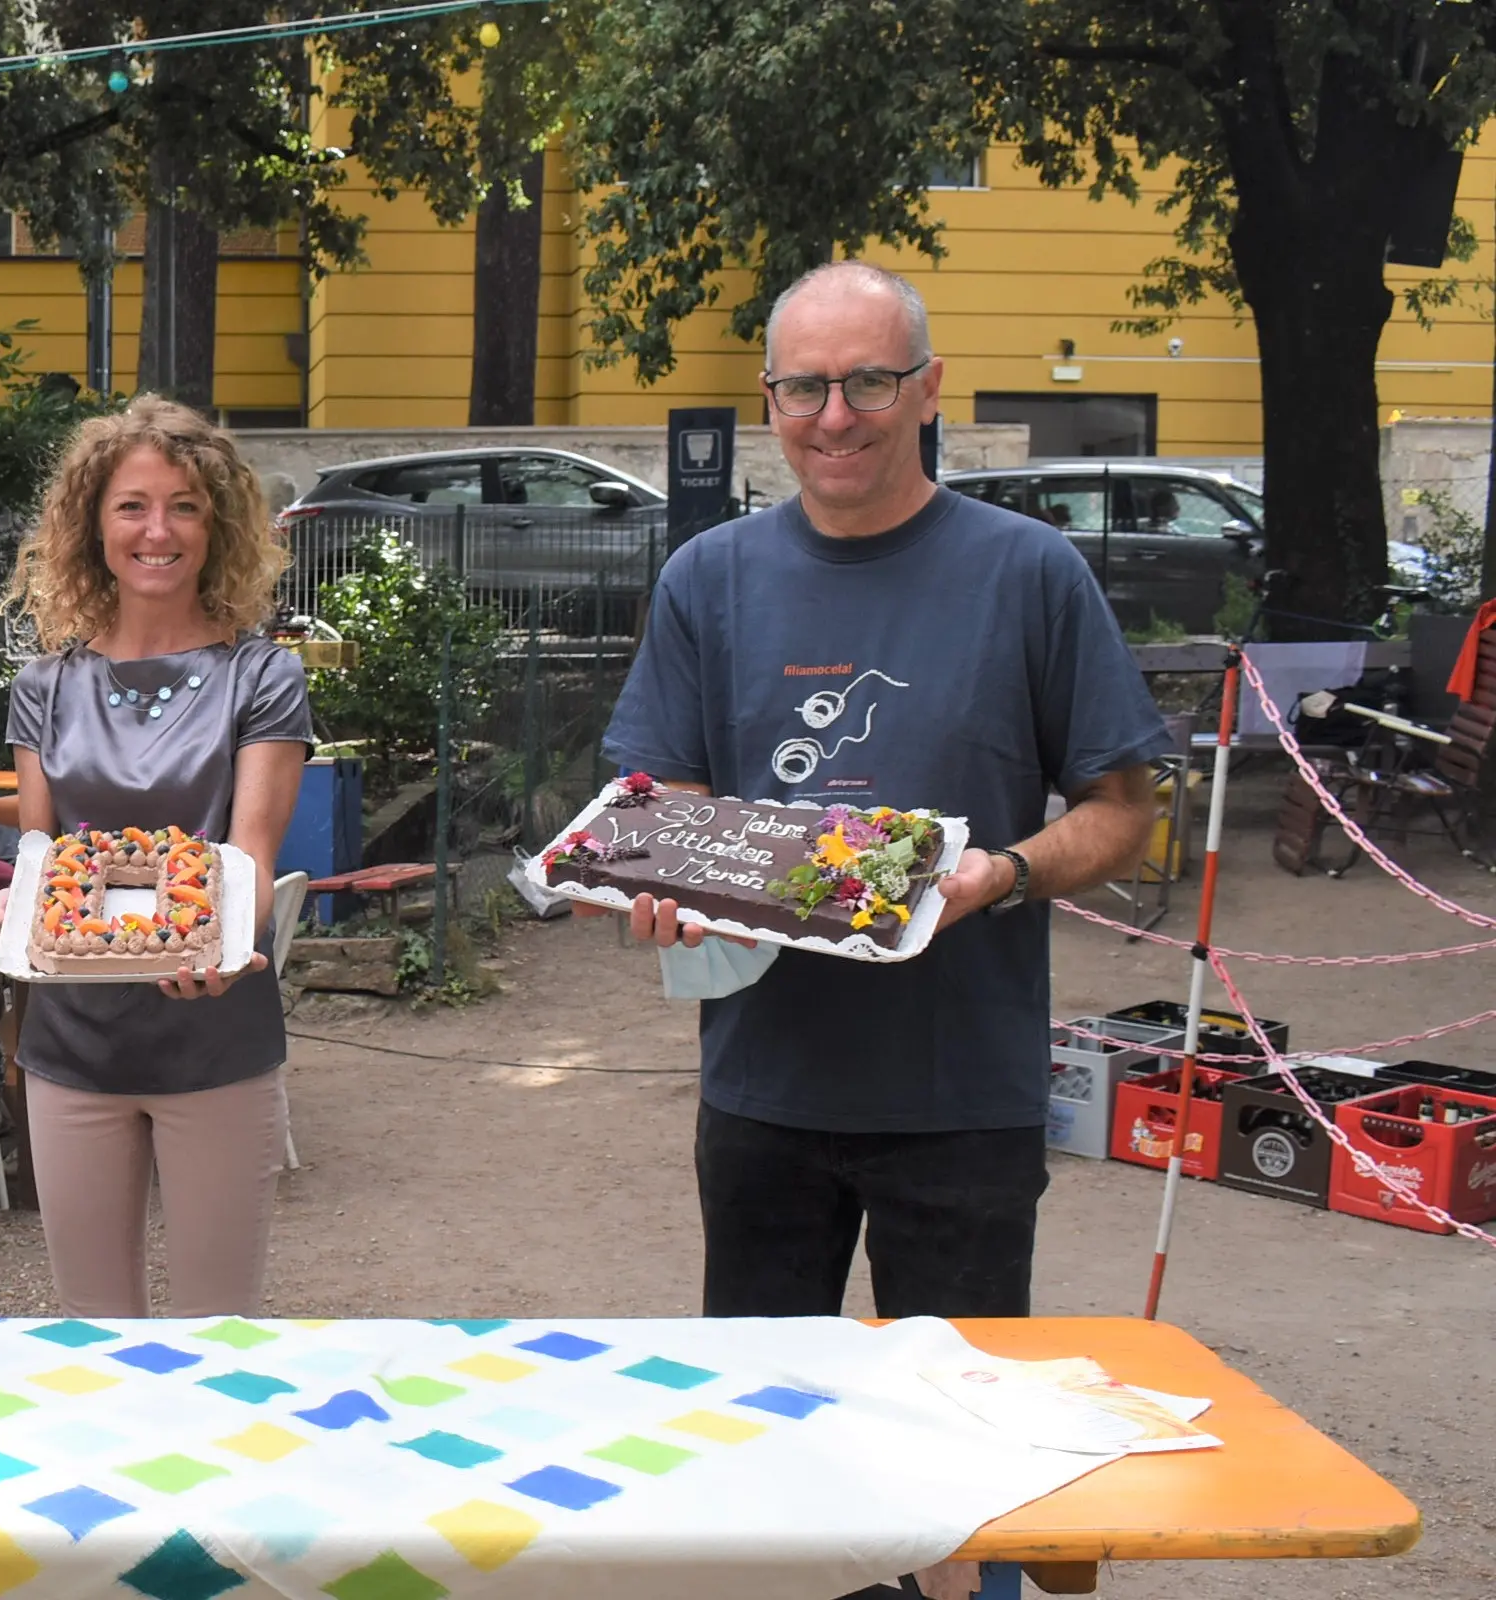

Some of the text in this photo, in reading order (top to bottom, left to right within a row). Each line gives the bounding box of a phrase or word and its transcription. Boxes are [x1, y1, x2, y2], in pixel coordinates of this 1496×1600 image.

[681, 477, 721, 488] TICKET
[654, 800, 808, 841] 30 Jahre
[607, 816, 774, 866] Weltladen
[657, 856, 766, 891] Meran
